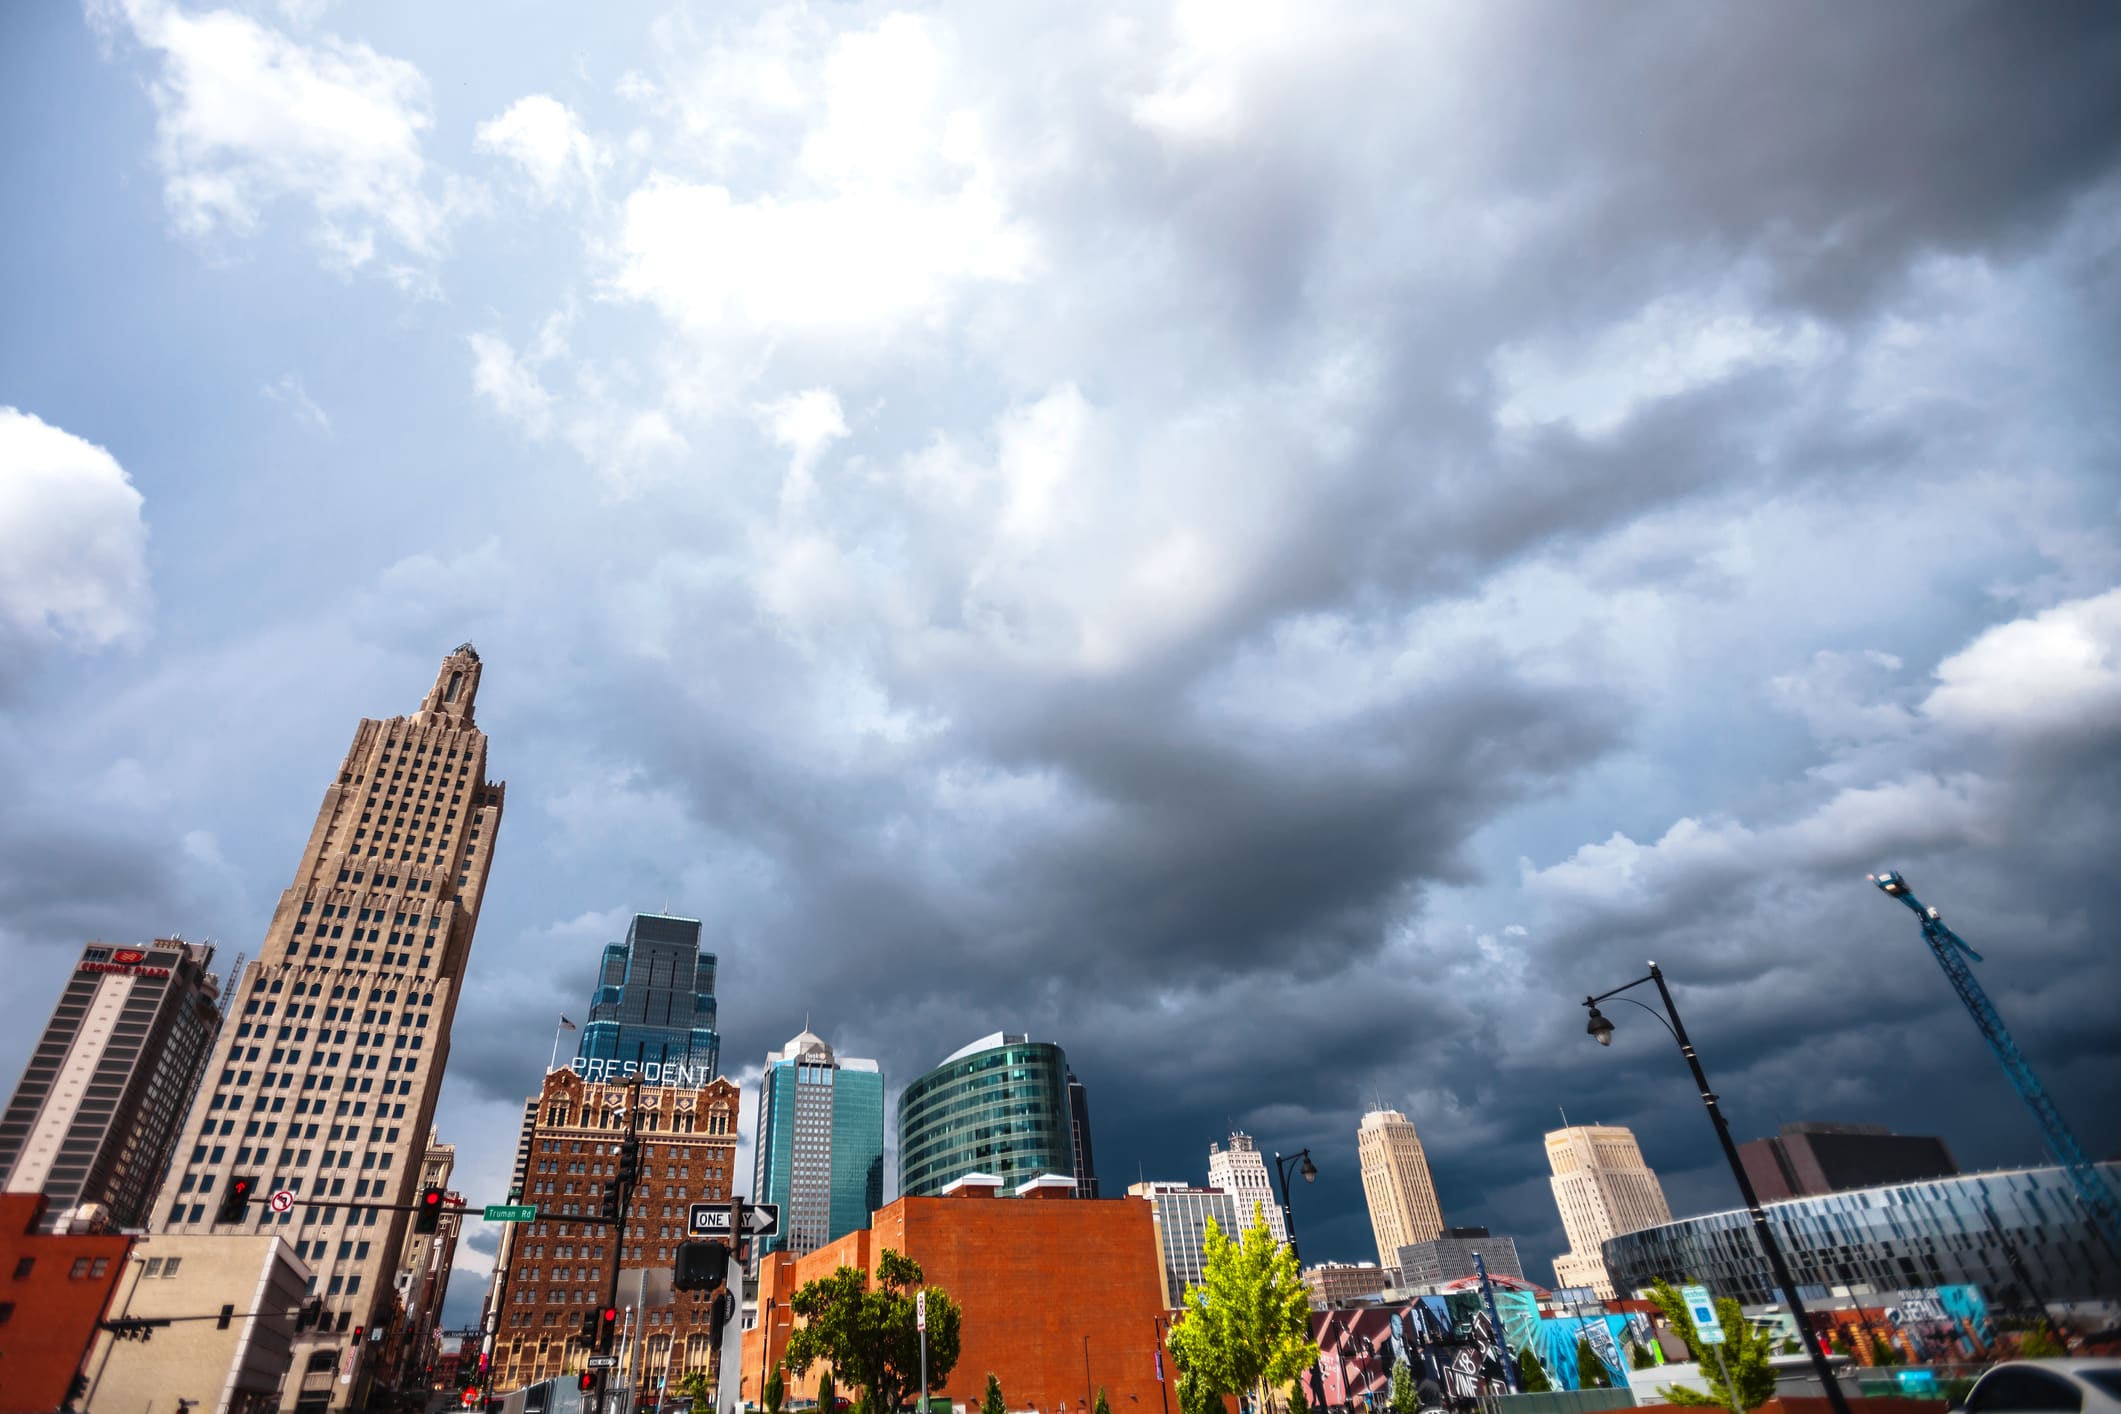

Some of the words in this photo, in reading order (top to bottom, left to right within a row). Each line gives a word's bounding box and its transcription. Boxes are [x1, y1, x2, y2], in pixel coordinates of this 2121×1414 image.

[81, 961, 130, 975] CROWNE
[133, 966, 169, 977] PLAZA
[571, 1057, 710, 1084] PRESIDENT
[489, 1209, 516, 1218] Truman
[521, 1209, 532, 1218] Rd
[700, 1213, 723, 1226] ONE
[728, 1213, 753, 1226] AY
